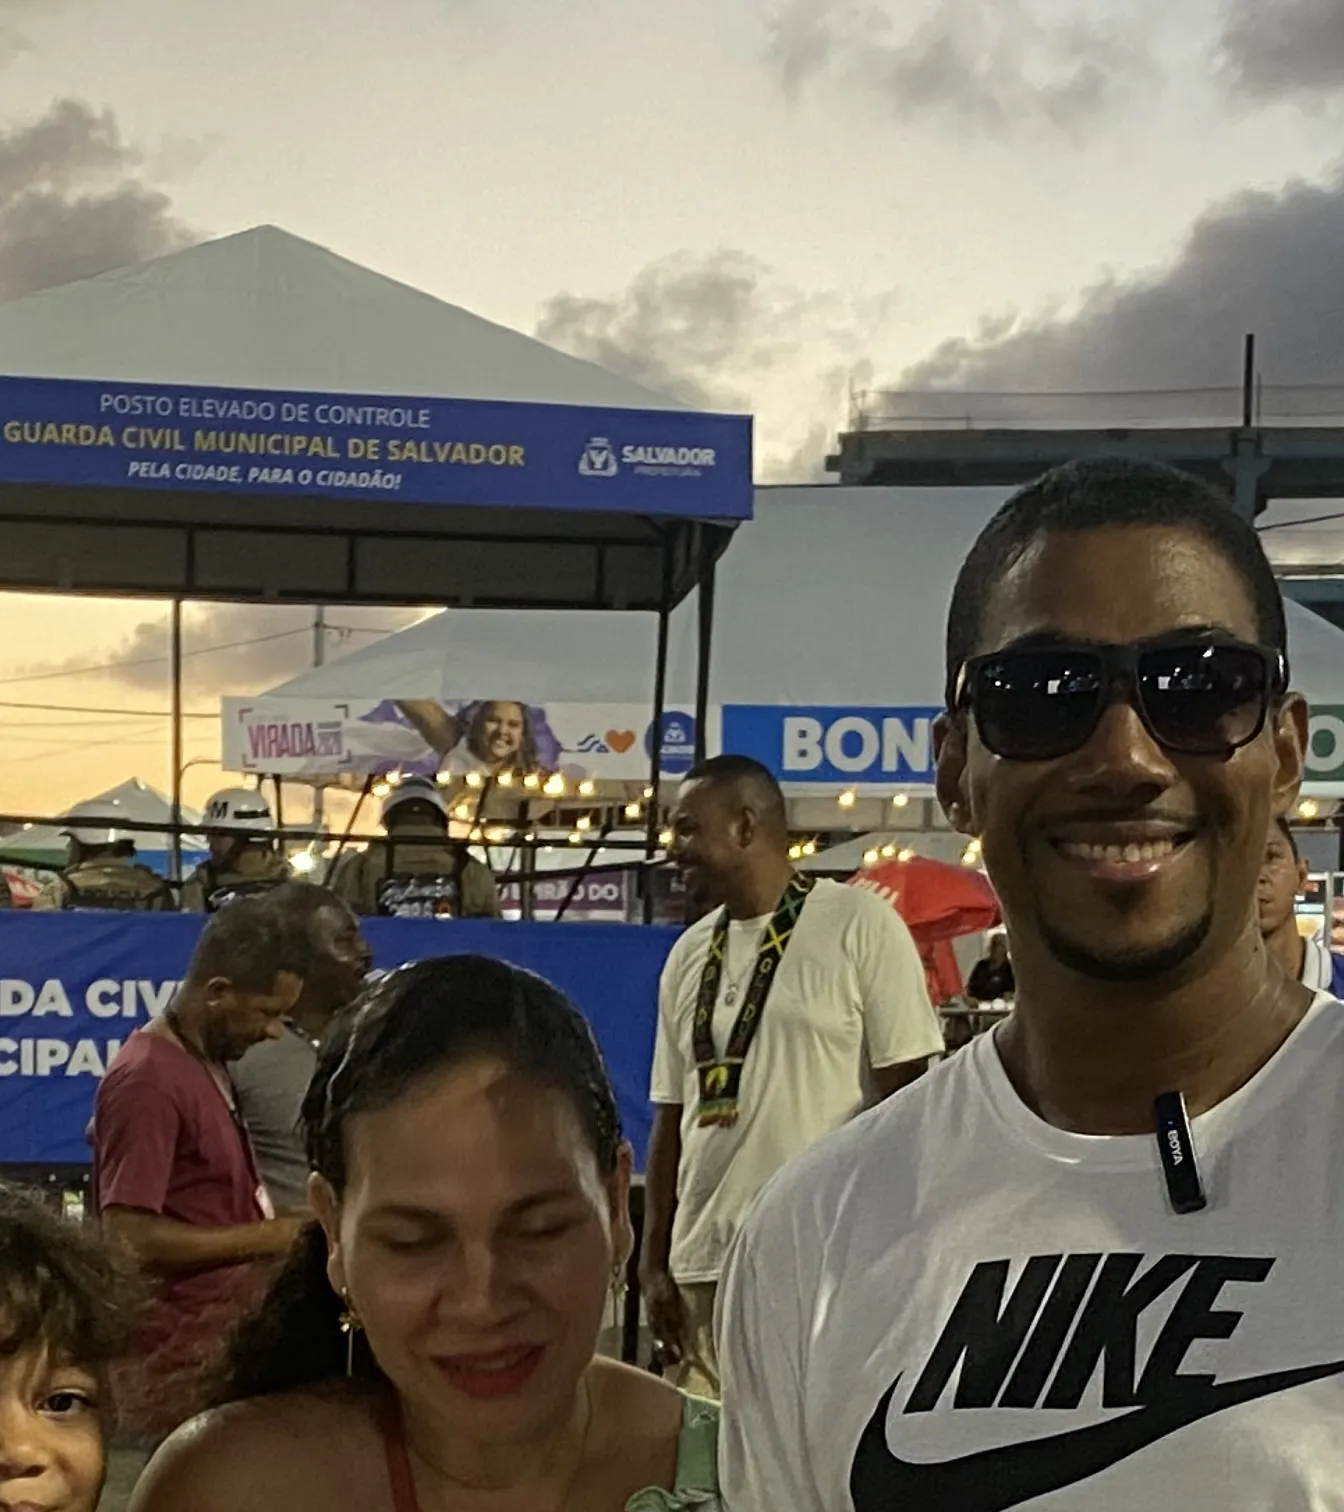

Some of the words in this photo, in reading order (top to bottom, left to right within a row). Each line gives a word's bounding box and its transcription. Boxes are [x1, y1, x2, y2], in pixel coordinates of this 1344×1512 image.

[99, 394, 173, 416] POSTO
[179, 398, 275, 421] ELEVADO
[281, 403, 309, 422] DE
[314, 404, 431, 428] CONTROLE
[3, 421, 115, 447] GUARDA
[122, 427, 185, 451] CIVIL
[194, 431, 340, 458] MUNICIPAL
[347, 438, 381, 460] DE
[387, 439, 525, 465] SALVADOR
[621, 445, 716, 466] SALVADOR
[128, 461, 170, 478] PELA
[175, 464, 242, 484] CIDADE,
[248, 467, 294, 484] PARA
[298, 470, 312, 485] O
[316, 469, 402, 490] CIDADÃO!
[84, 979, 184, 1018] CIV
[1167, 1129, 1184, 1166] BOYA
[903, 1253, 1277, 1415] NIKE
